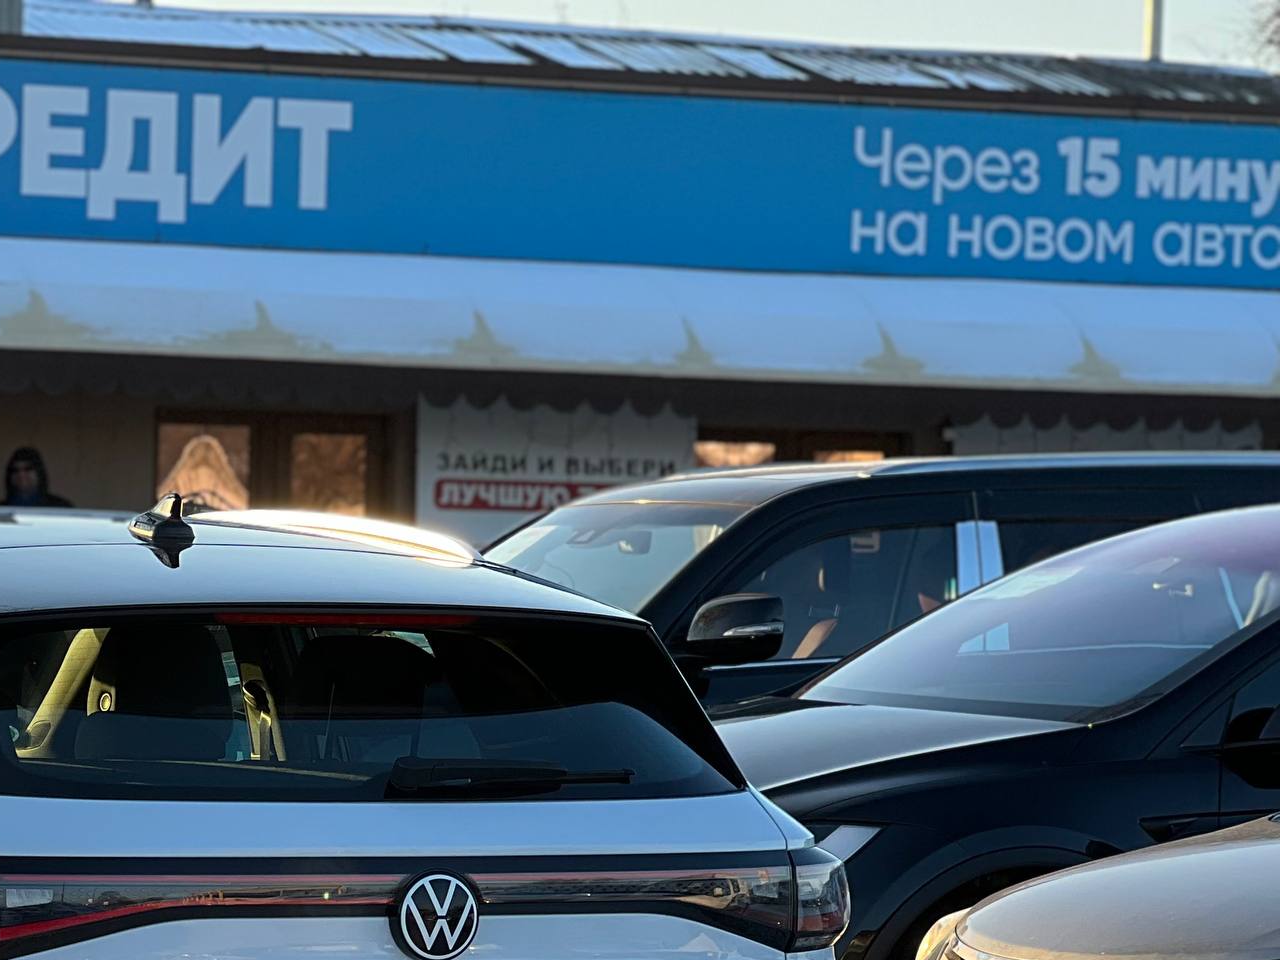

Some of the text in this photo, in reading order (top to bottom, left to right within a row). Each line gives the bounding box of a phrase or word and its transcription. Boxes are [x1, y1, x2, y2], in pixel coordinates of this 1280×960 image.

[853, 126, 1280, 218] Через 15 мину
[850, 209, 1280, 270] на новом авто
[436, 453, 677, 477] ЗАЙДИ И ВЫБЕРИ
[440, 482, 570, 508] ЛУЧШУЮ
